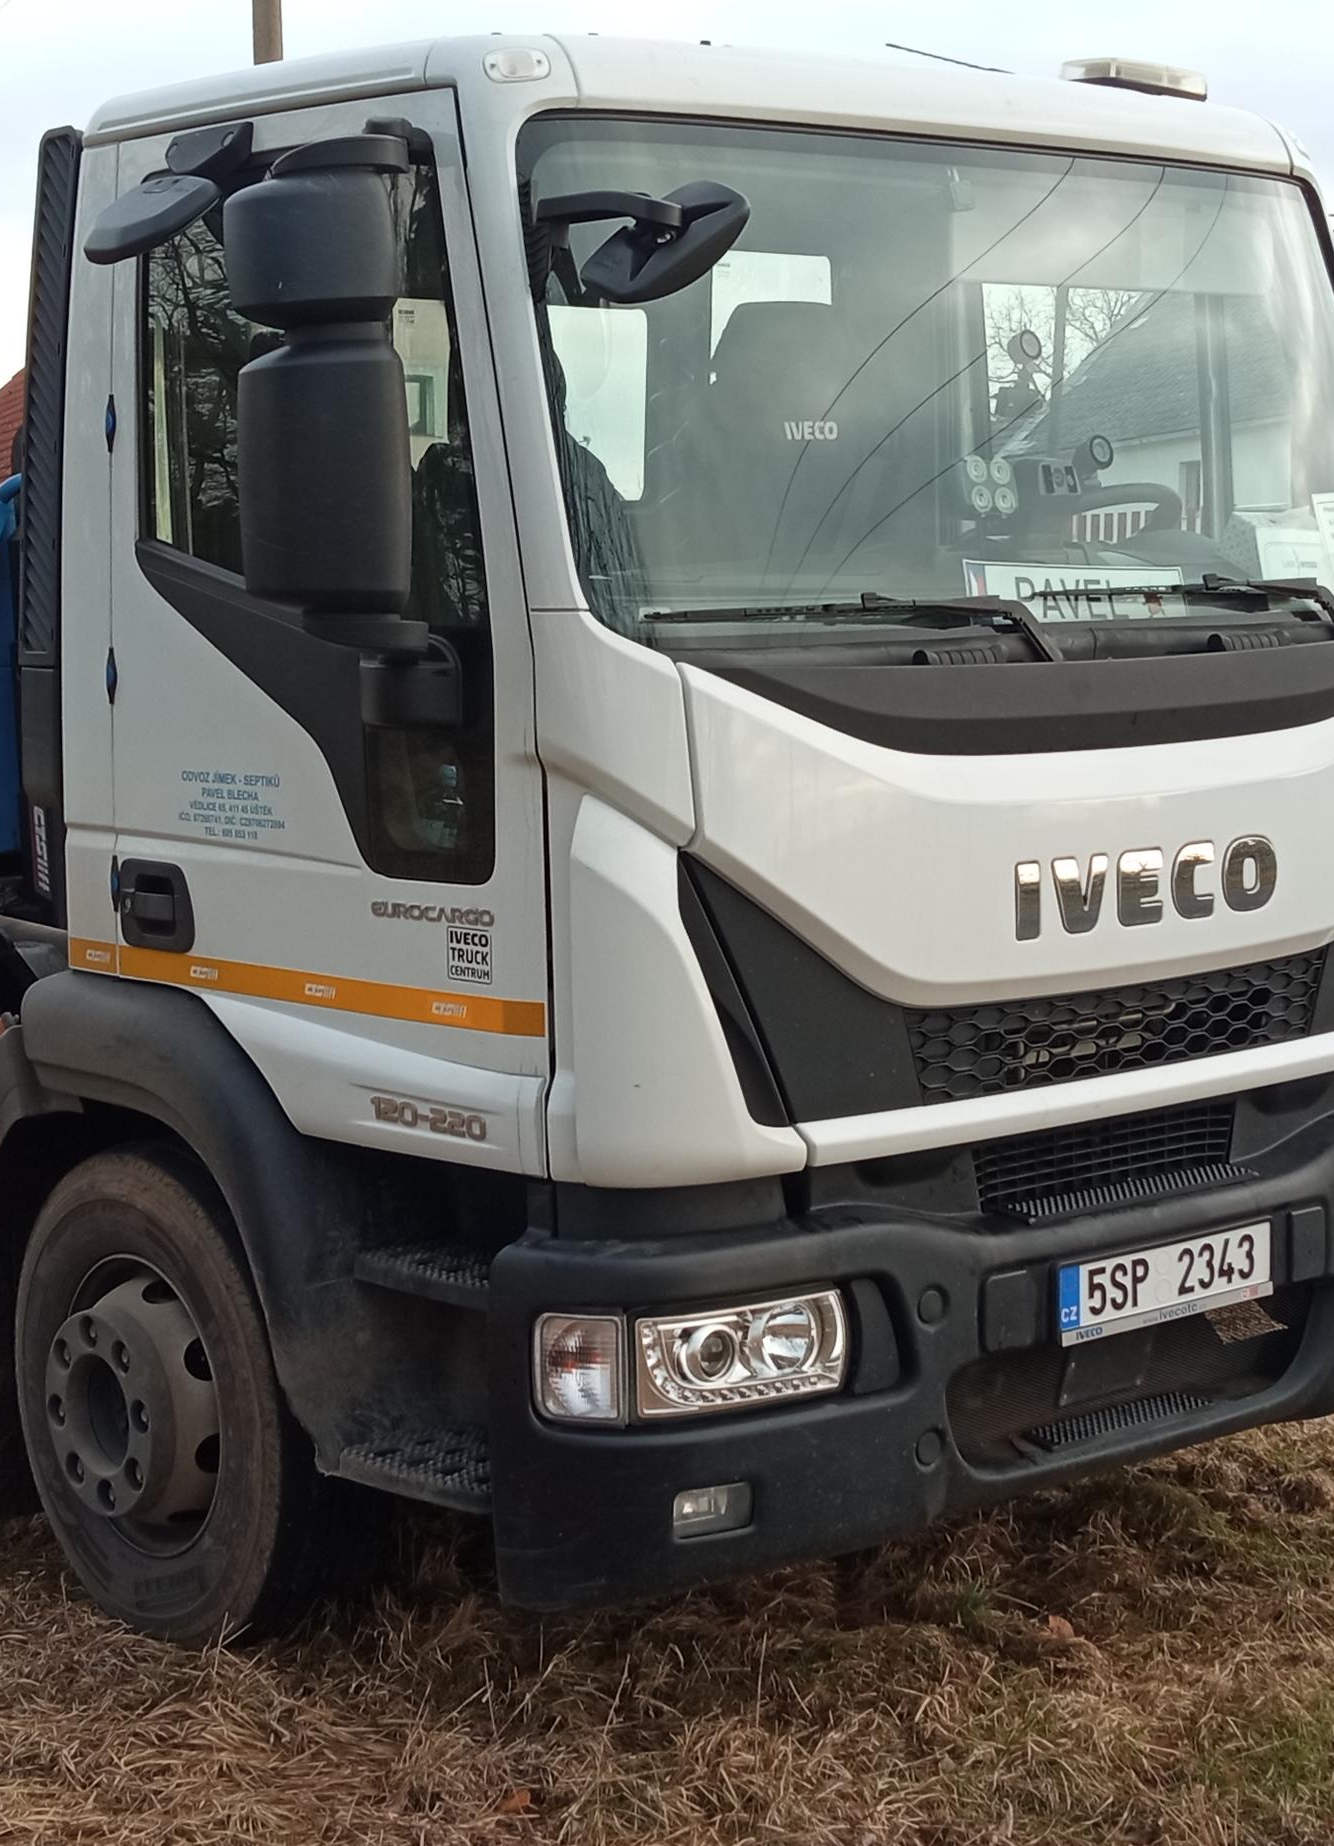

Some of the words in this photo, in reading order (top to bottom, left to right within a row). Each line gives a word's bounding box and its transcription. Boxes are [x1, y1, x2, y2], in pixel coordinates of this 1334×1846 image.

[783, 421, 838, 440] IVECO
[1014, 576, 1129, 620] PAVEL
[181, 770, 210, 784] ODVOZ
[201, 787, 226, 799] PAVEL
[1014, 833, 1278, 942] IVECO
[370, 901, 495, 927] EUROCARGO
[449, 930, 489, 948] IVECO
[449, 947, 490, 966] TRUCK
[450, 965, 490, 981] CENTRUM
[370, 1095, 487, 1142] 120-220
[1088, 1257, 1149, 1316] 5SP
[1177, 1233, 1255, 1296] 2343
[1061, 1306, 1077, 1322] CZ
[1075, 1327, 1103, 1341] IVECO
